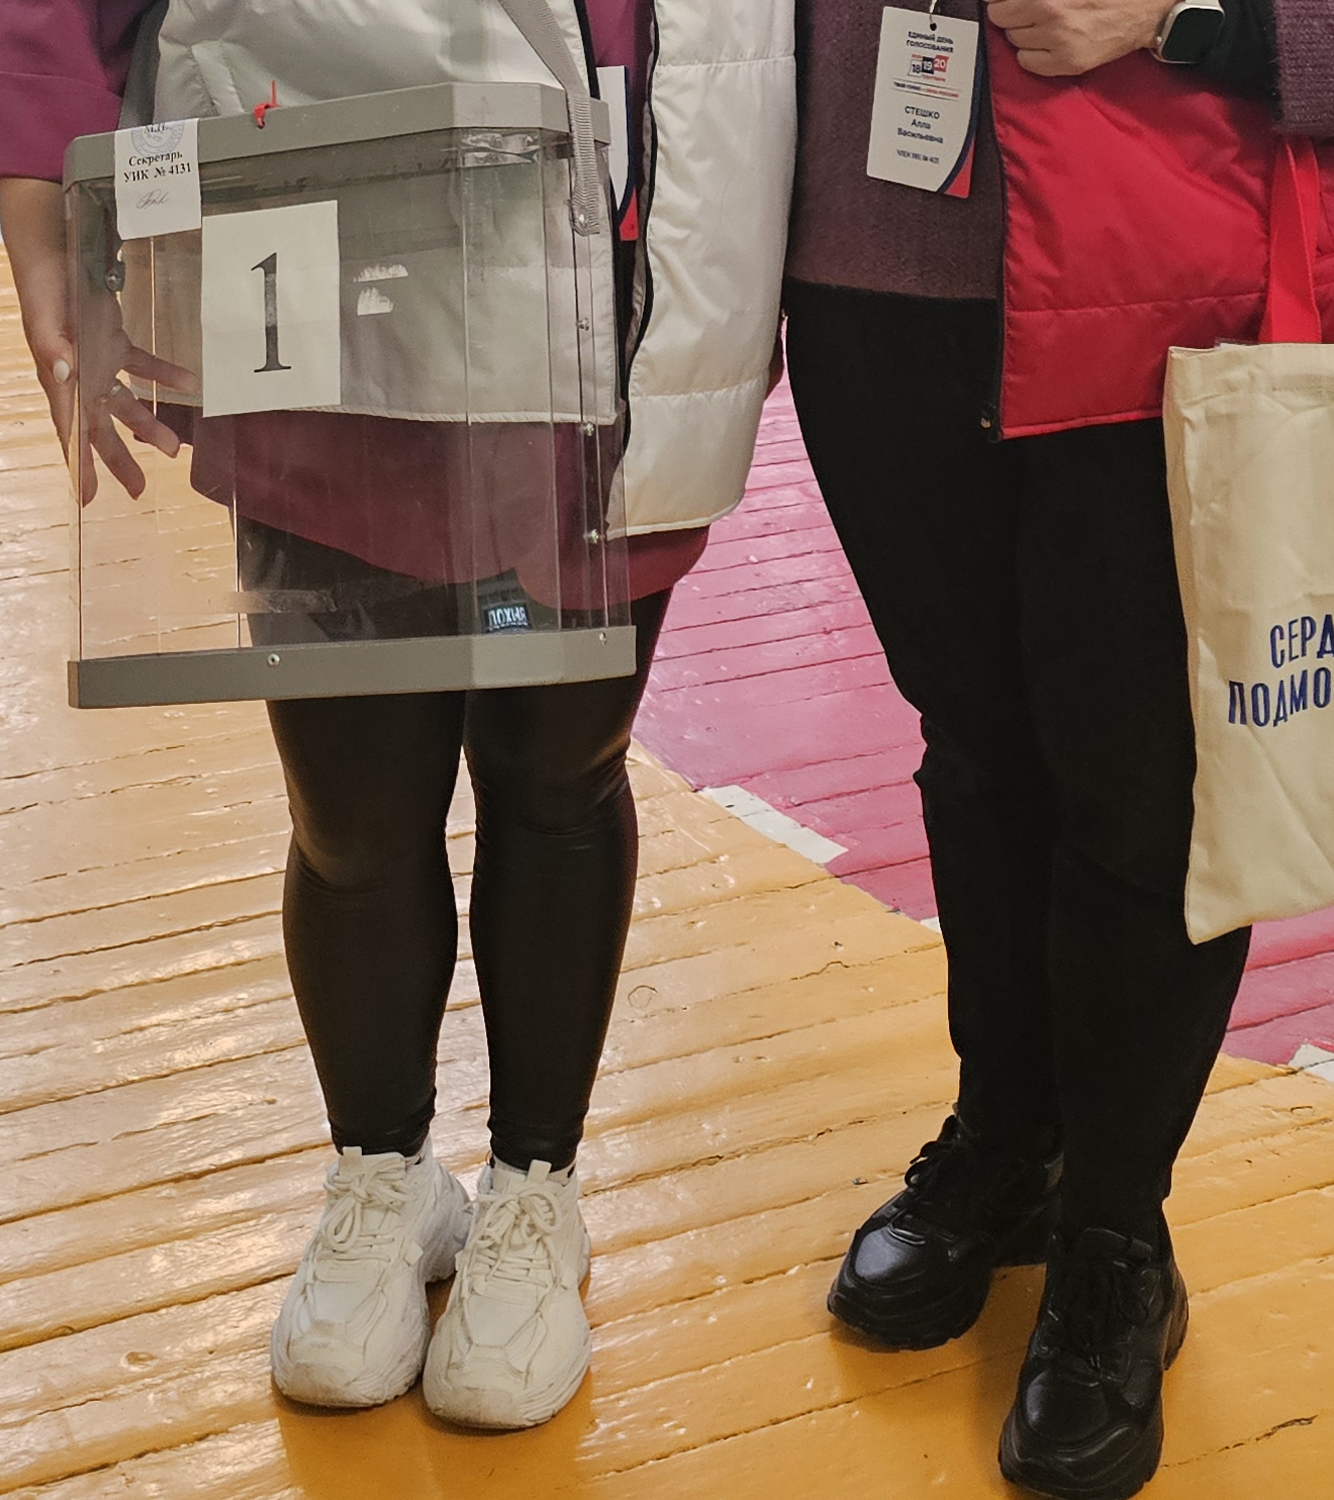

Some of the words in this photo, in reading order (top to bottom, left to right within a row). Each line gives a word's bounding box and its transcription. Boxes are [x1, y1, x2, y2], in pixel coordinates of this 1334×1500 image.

[912, 63, 921, 74] 18
[923, 60, 933, 72] 19
[934, 58, 946, 69] 20
[128, 151, 183, 167] Секретарь
[123, 169, 149, 183] УИК
[154, 166, 166, 178] №
[168, 163, 191, 174] 4131
[250, 252, 292, 374] 1
